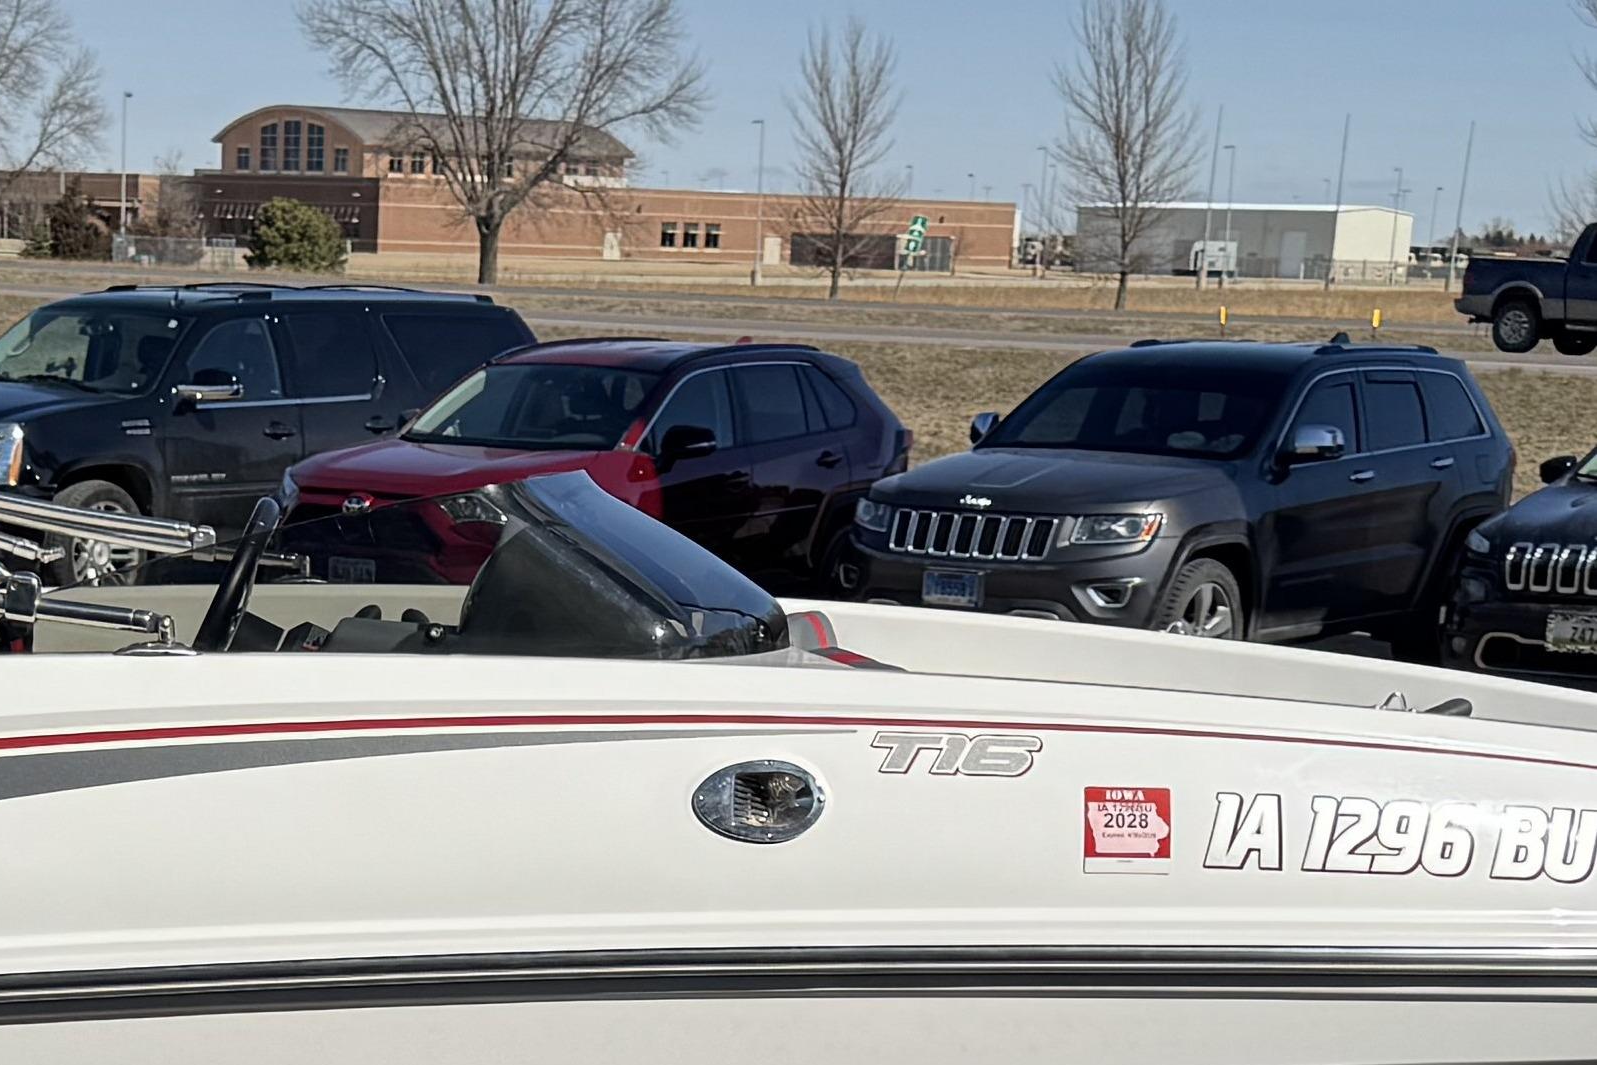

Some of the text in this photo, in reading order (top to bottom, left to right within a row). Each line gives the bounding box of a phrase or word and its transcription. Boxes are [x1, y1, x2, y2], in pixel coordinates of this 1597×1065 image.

[870, 731, 1044, 777] T16
[1105, 789, 1145, 801] IOWA
[1103, 812, 1149, 829] 2028
[1300, 795, 1476, 877] 1296
[1490, 804, 1597, 884] BU
